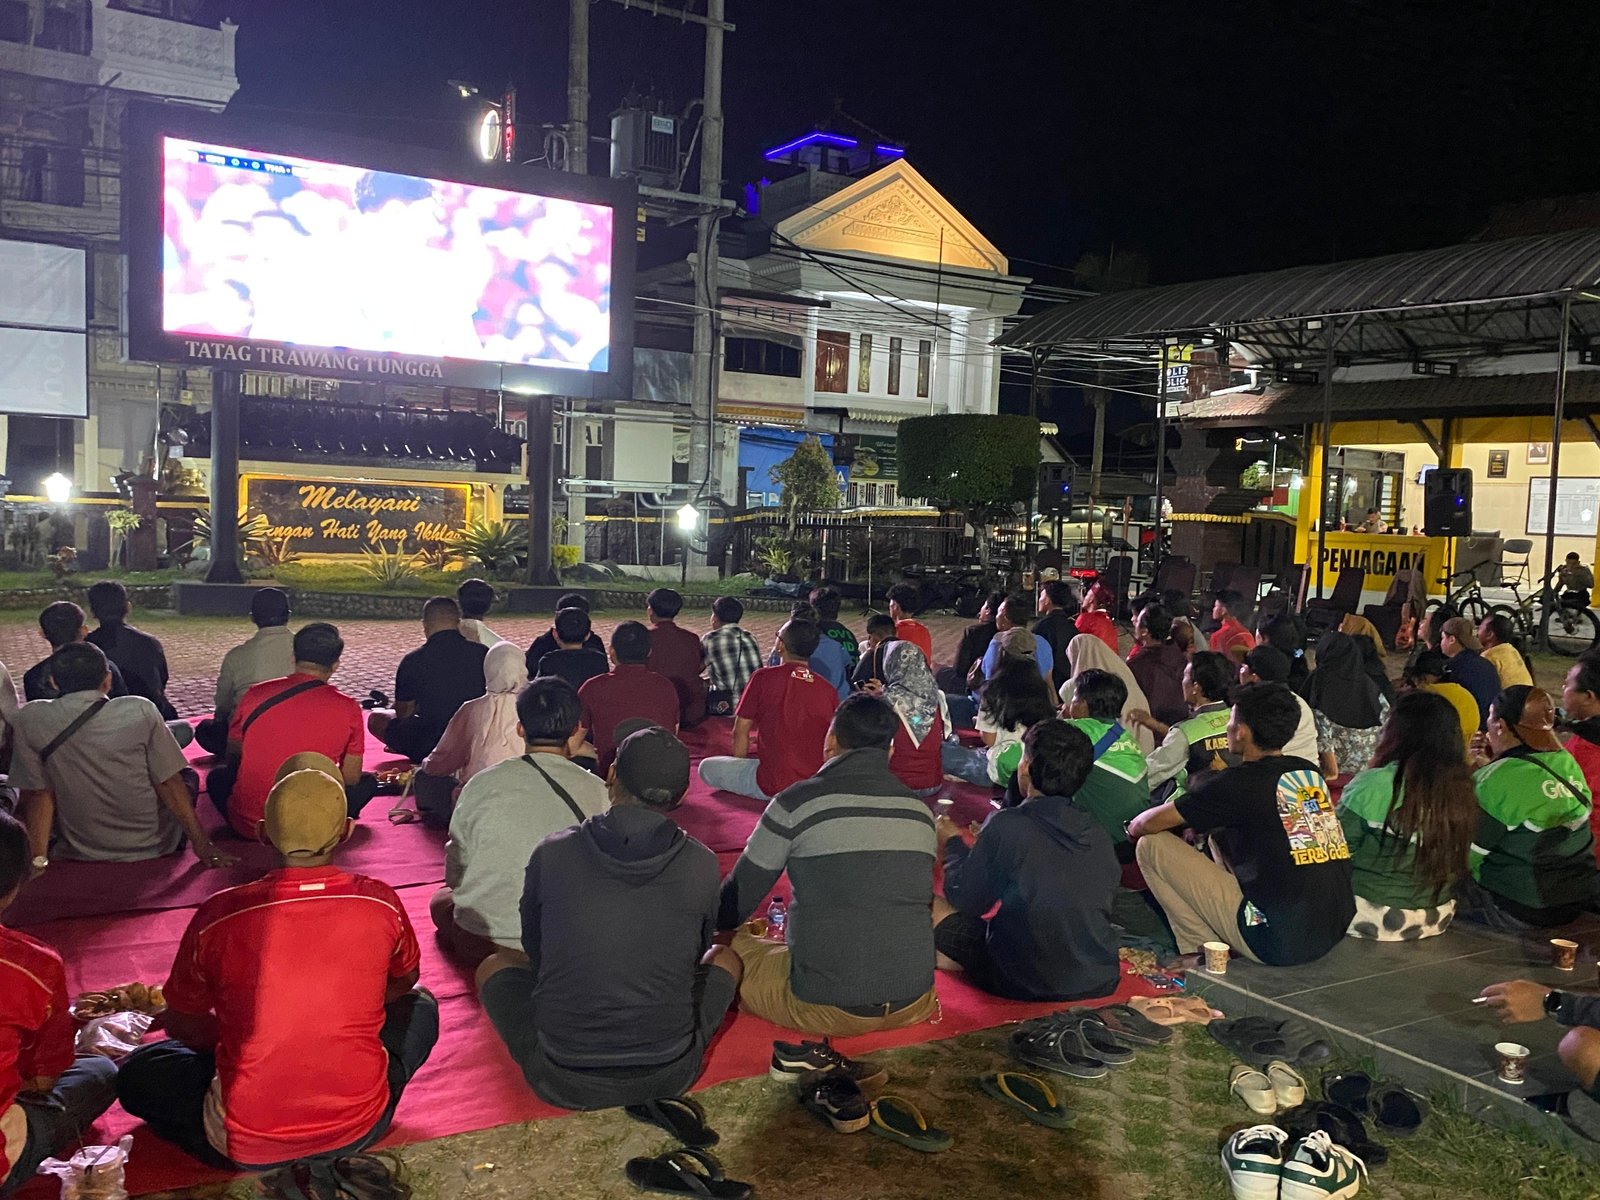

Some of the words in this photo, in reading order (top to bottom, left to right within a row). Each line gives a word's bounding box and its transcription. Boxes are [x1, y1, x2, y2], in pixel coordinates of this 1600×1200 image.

[184, 340, 251, 362] TATAG
[256, 347, 360, 372] TRAWANG
[363, 357, 444, 378] TUNGGA
[298, 484, 421, 516] Melayani
[319, 518, 360, 539] Hati
[366, 519, 408, 545] Yang
[1290, 847, 1330, 865] TERAS
